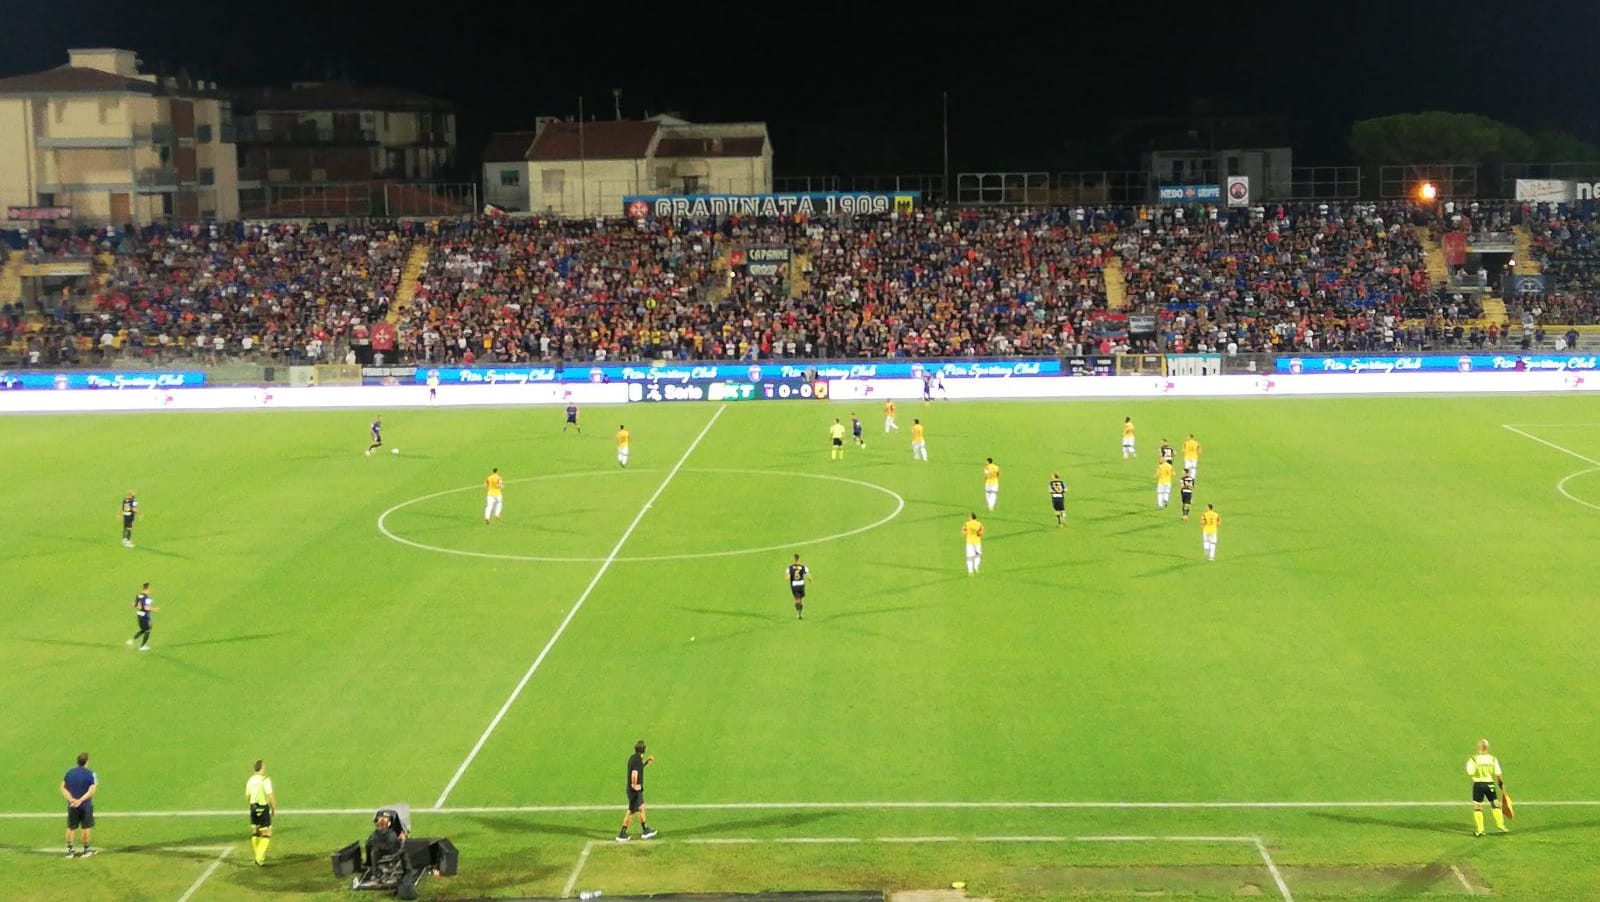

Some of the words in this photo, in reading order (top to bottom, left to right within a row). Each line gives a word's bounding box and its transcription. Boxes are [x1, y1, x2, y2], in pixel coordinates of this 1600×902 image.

[655, 196, 815, 218] GRADINATA
[826, 195, 889, 216] 1909
[749, 248, 789, 260] CAPANNE
[850, 364, 876, 377] Club
[968, 363, 1013, 379] Sporting
[1013, 362, 1040, 374] Club
[1348, 358, 1394, 374] Sporting
[1394, 357, 1422, 369] Club
[1567, 357, 1596, 369] Club
[111, 375, 157, 390] Sporting
[157, 374, 185, 386] Club
[483, 369, 528, 384] Sporting
[528, 368, 556, 380] Club
[646, 367, 691, 383] Sporting
[691, 366, 718, 378] Club
